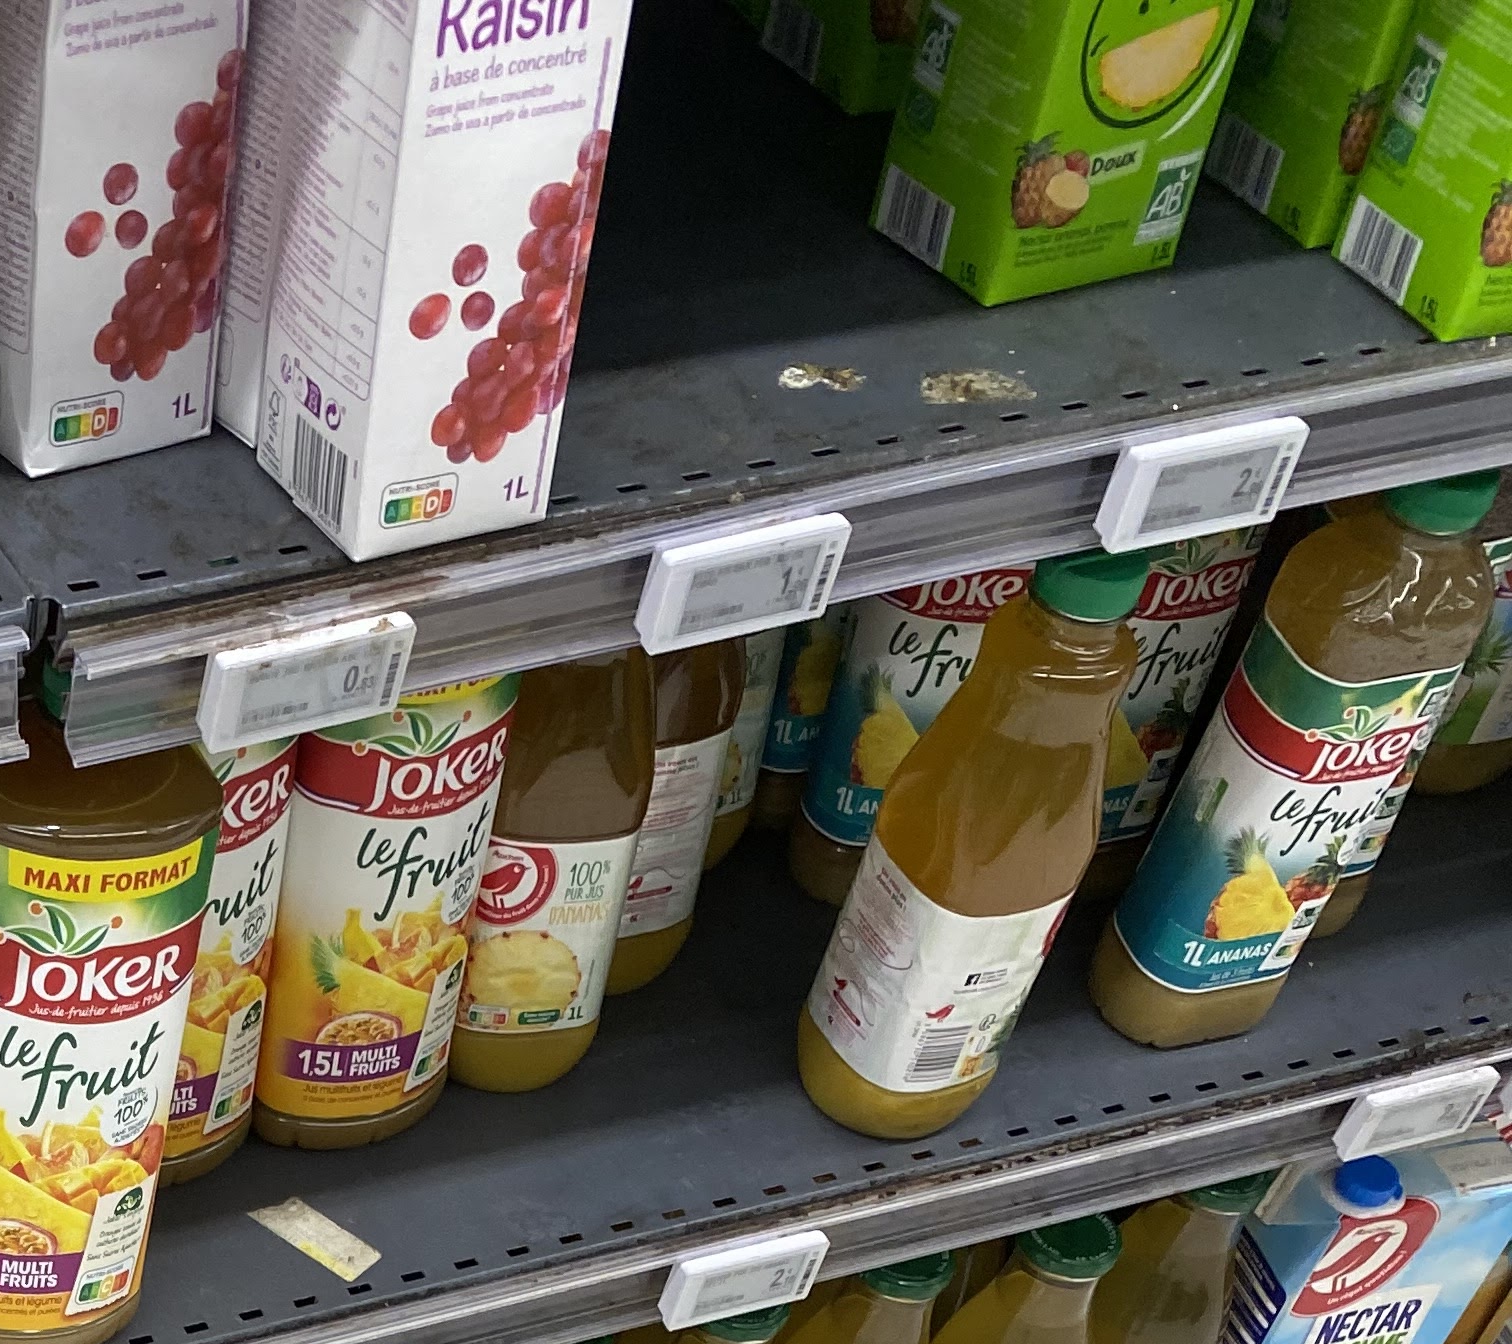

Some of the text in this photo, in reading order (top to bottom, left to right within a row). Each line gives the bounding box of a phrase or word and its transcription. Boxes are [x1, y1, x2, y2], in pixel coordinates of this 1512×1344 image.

[443, 65, 480, 89] base
[484, 55, 504, 80] de
[508, 45, 587, 76] concentré
[1090, 150, 1138, 177] Doux
[172, 392, 197, 419] 1L
[503, 475, 529, 502] 1L
[912, 573, 1024, 611] JOKE
[888, 620, 922, 656] le
[363, 727, 509, 814] JOKER
[836, 786, 854, 815] 1L
[1270, 788, 1307, 822] le
[23, 855, 192, 893] MAXI FORMAT
[356, 800, 491, 922] le fruit
[569, 859, 612, 888] 100%
[1183, 940, 1274, 968] 1L ANANAS
[4, 943, 181, 1007] JOKER
[28, 991, 164, 1020] Jus-de-fruitier depuis 1936
[348, 1056, 401, 1077] FRUITS
[351, 1044, 399, 1064] MULTI
[19, 1020, 165, 1128] fruit
[0, 1272, 59, 1290] FRUITS
[1, 1258, 54, 1276] MULTI
